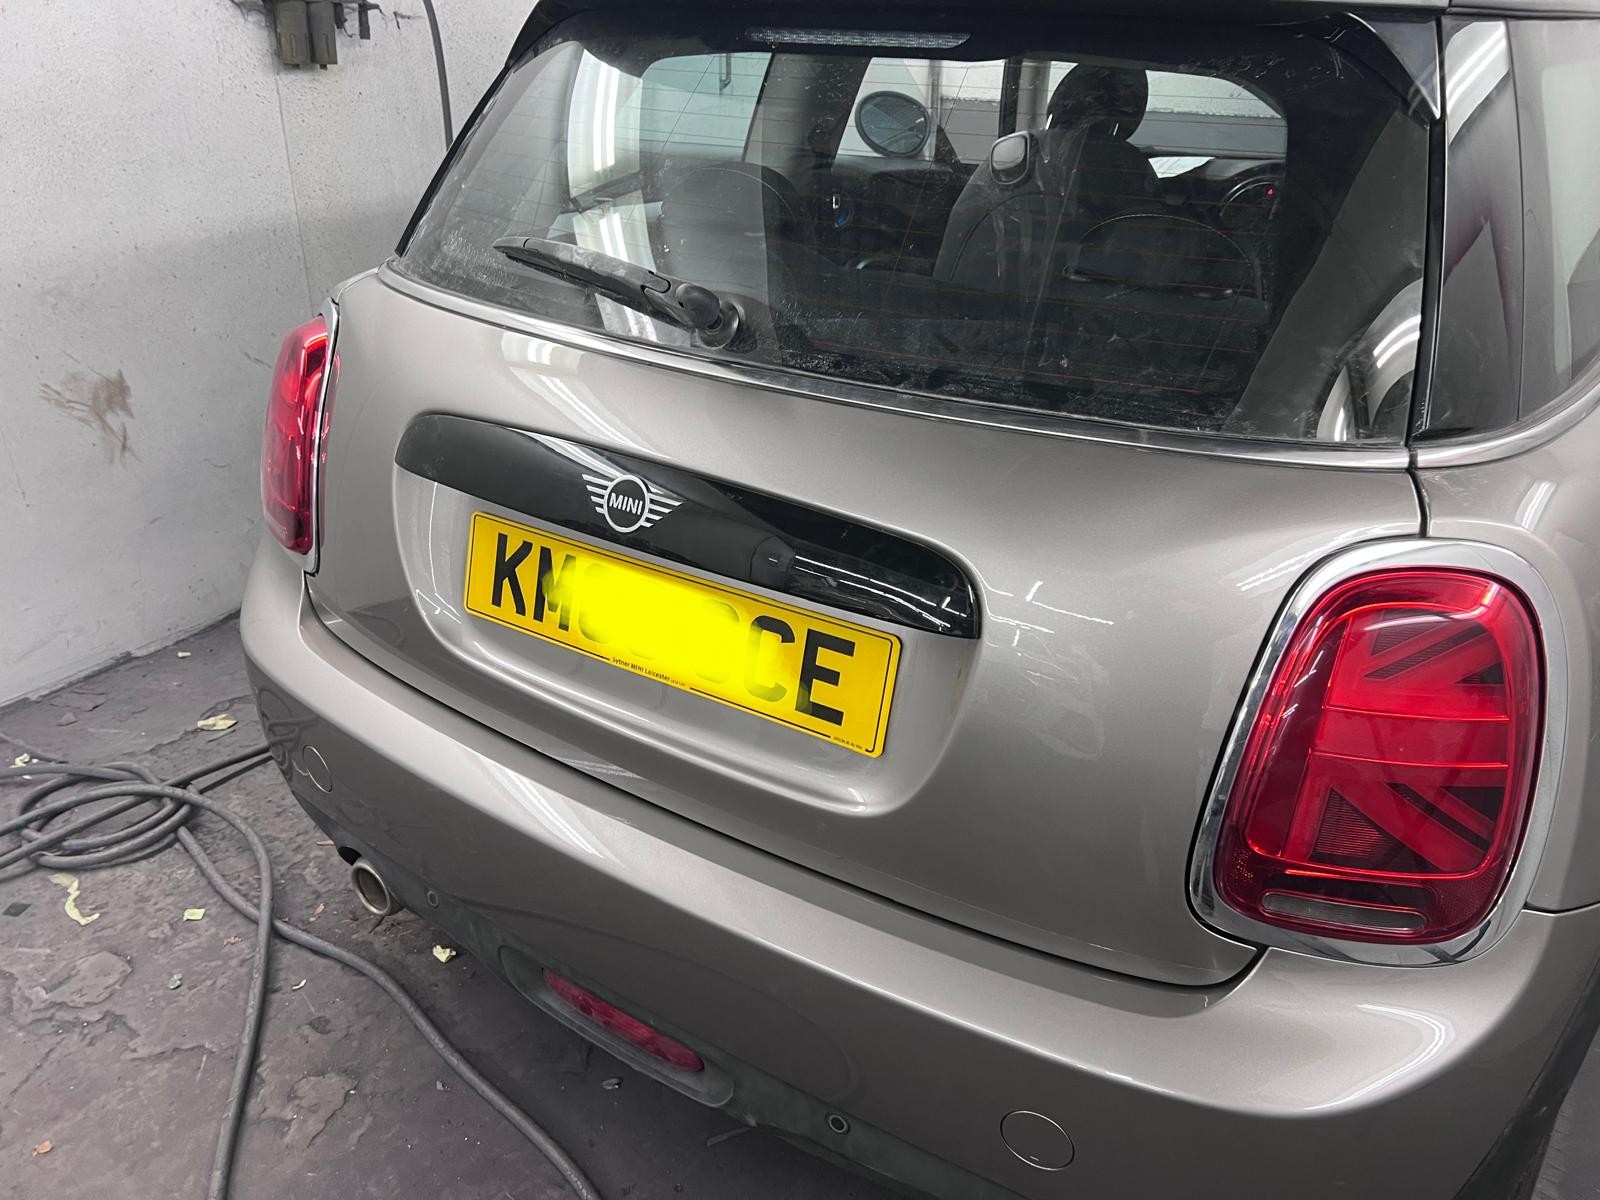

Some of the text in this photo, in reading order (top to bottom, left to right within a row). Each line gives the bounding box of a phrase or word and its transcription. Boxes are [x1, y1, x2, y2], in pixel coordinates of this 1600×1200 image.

[609, 492, 643, 515] MINI
[612, 656, 671, 682] Sytner MINI Leicester
